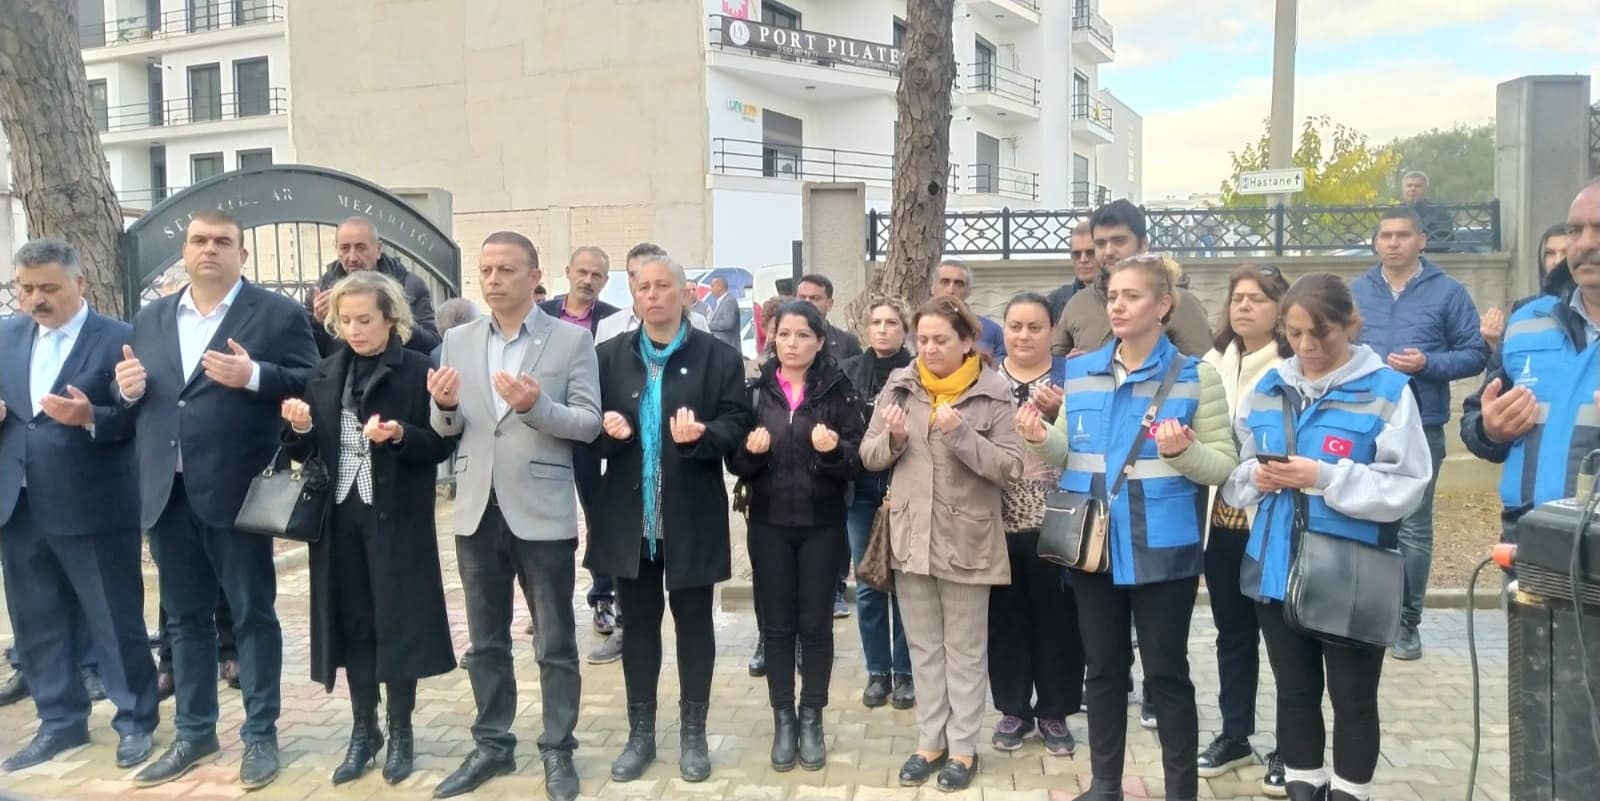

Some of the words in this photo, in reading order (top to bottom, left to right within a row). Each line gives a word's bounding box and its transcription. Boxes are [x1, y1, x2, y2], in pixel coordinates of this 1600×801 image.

[759, 26, 816, 50] PORT
[826, 38, 905, 65] PILATE
[1250, 177, 1292, 187] Hastane
